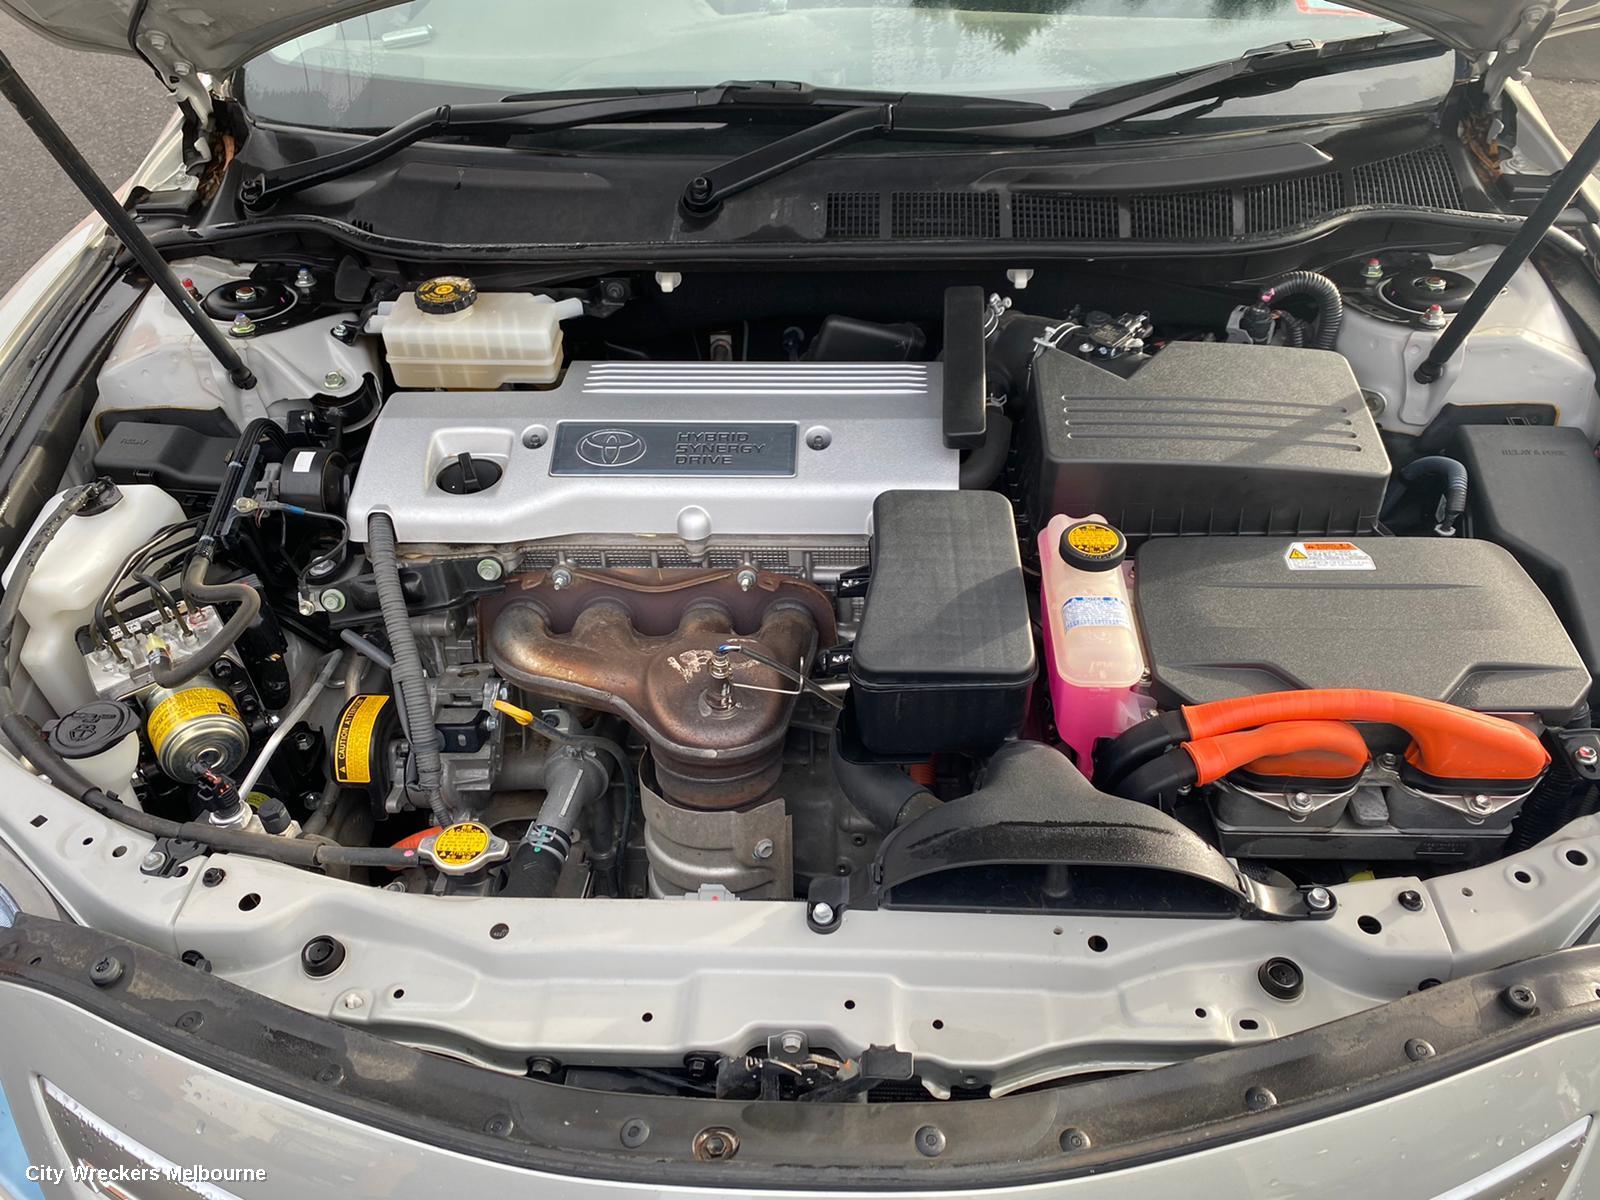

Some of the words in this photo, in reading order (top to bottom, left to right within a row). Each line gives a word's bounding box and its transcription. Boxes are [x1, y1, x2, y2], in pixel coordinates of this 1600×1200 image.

[676, 432, 750, 442] HYBRID
[675, 443, 766, 454] SYNERGY
[674, 454, 734, 465] DRIVE
[338, 726, 348, 760] CAUTION
